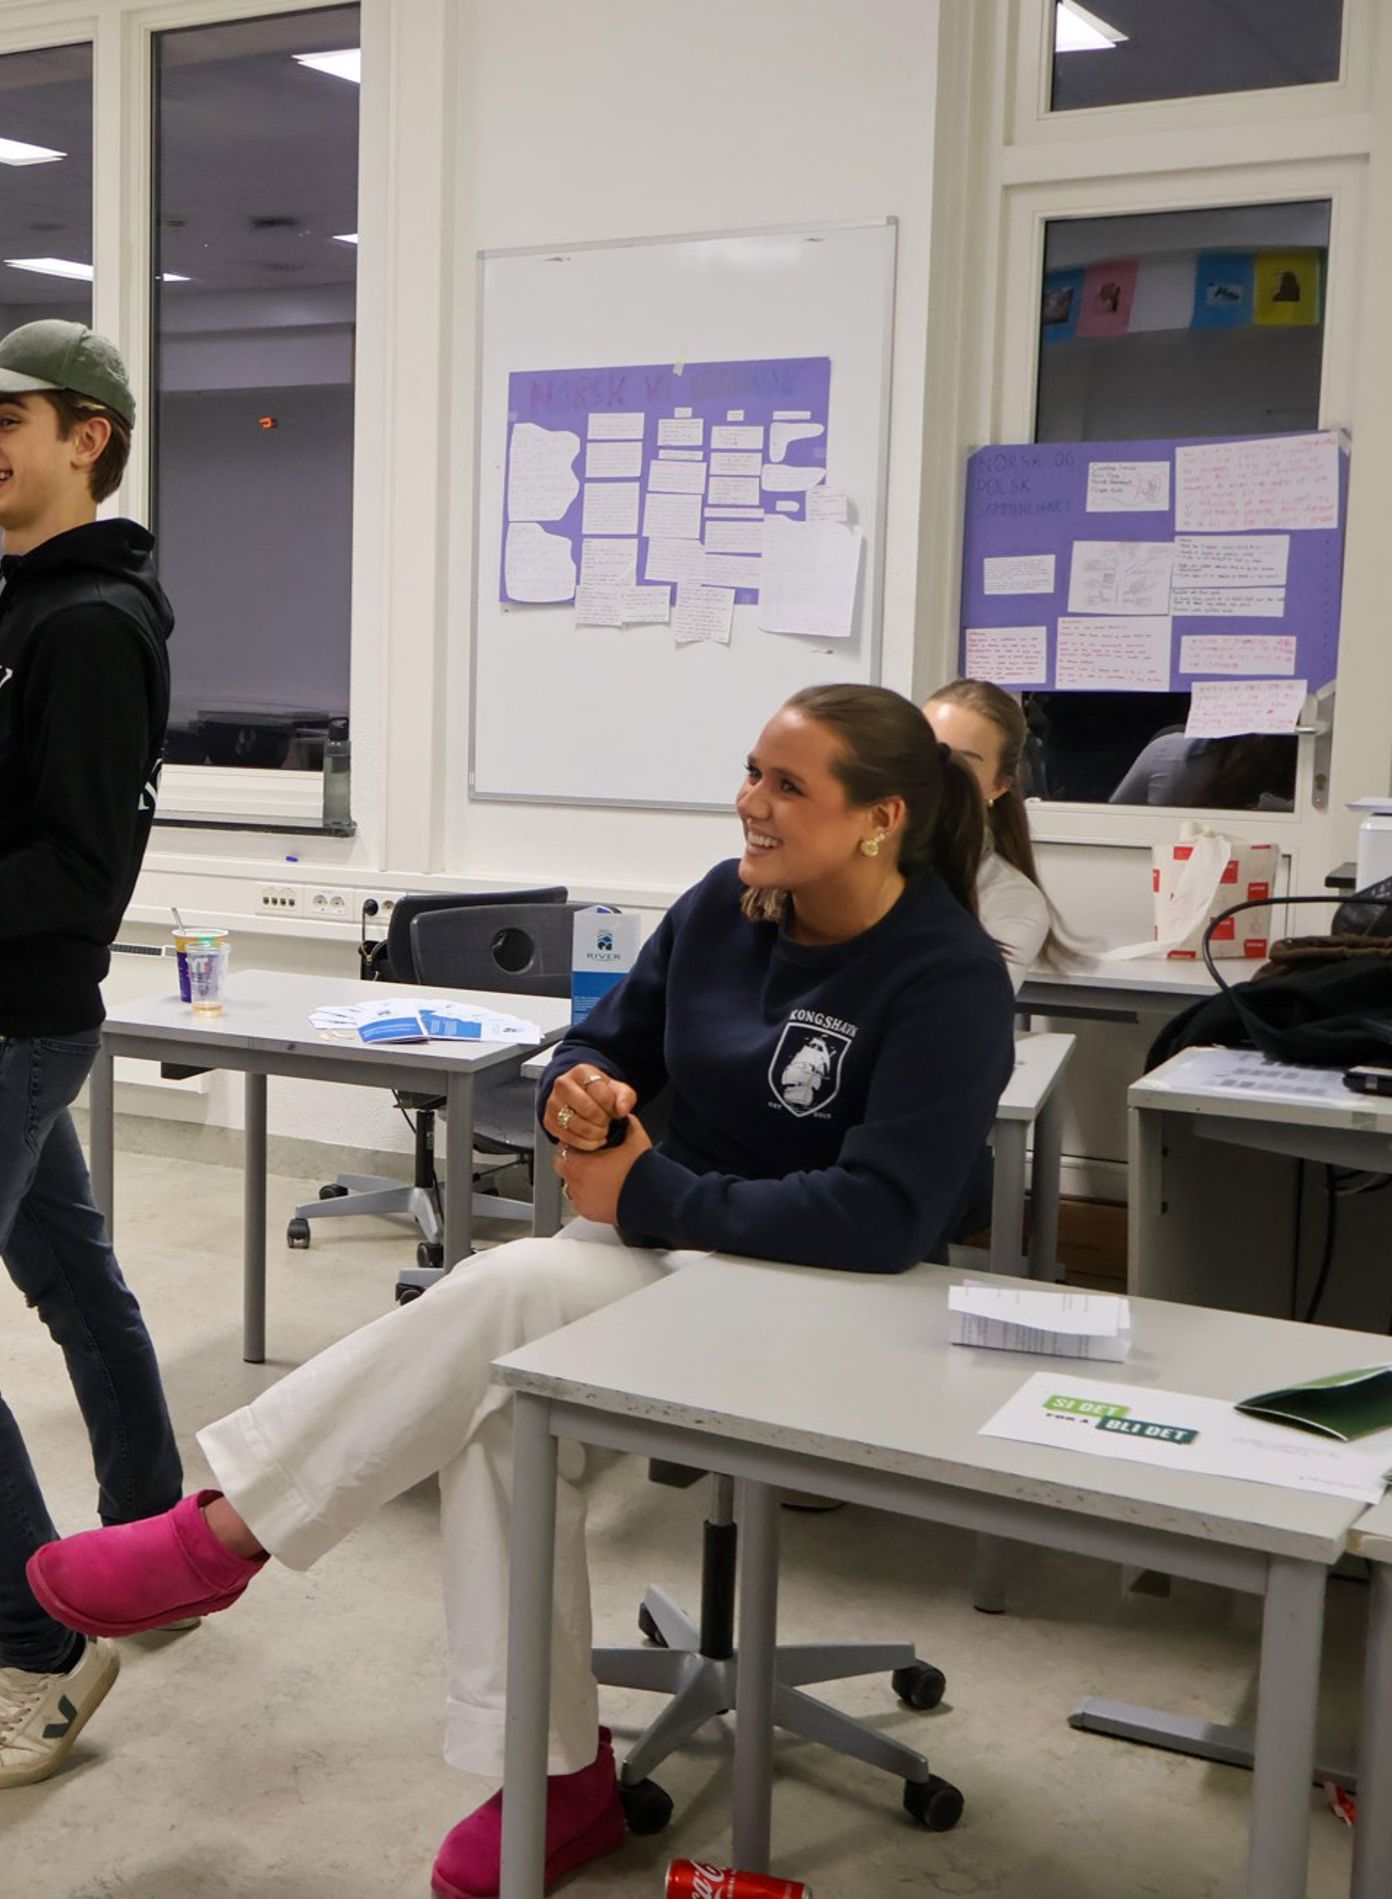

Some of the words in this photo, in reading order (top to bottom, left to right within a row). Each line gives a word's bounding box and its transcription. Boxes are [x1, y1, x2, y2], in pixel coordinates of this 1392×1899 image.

[1053, 1397, 1074, 1410] SI
[1079, 1403, 1120, 1416] DET
[1104, 1419, 1142, 1434] BLI
[1144, 1425, 1189, 1441] DET
